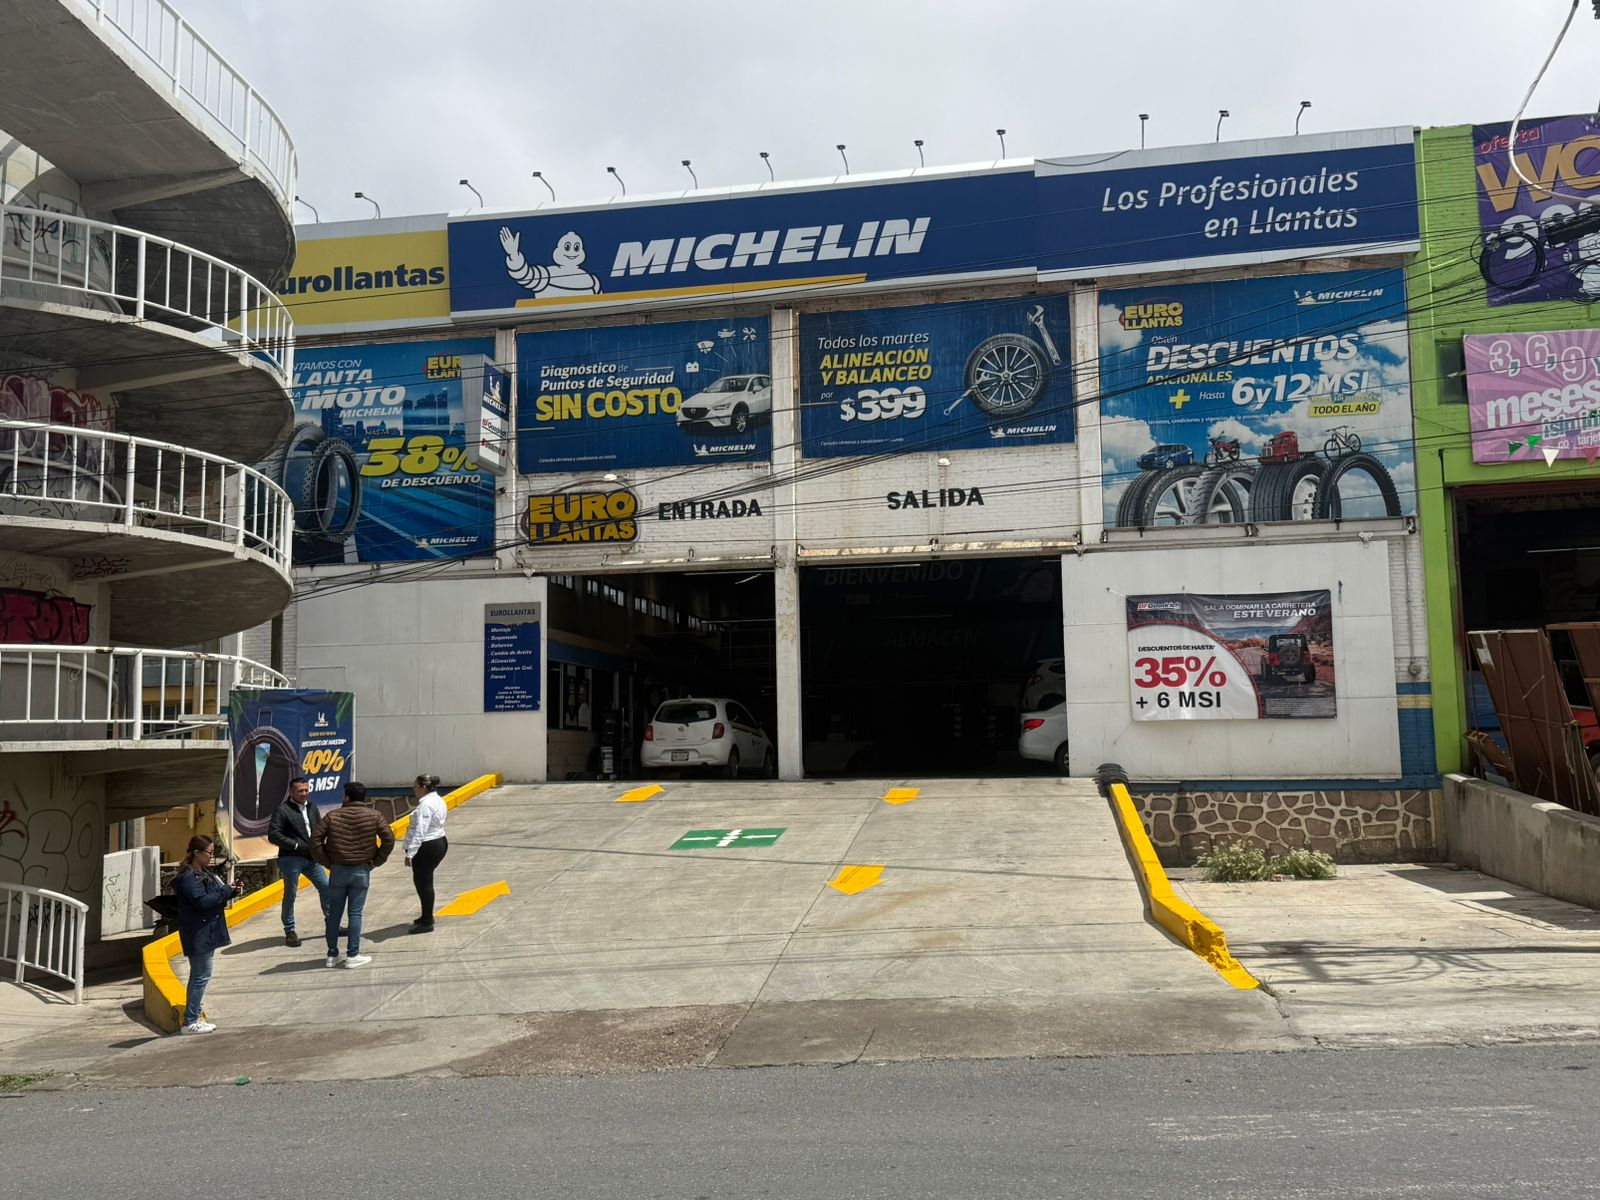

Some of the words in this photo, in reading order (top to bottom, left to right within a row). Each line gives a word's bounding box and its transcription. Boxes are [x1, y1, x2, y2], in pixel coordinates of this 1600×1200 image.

[1479, 127, 1539, 154] ofeta
[1476, 135, 1600, 212] WO
[1102, 187, 1150, 212] Los
[1159, 167, 1358, 211] Profesionales
[1204, 215, 1239, 238] en
[1249, 206, 1358, 235] Llantas
[610, 217, 931, 277] MICHELIN
[277, 263, 445, 296] urollantas
[1317, 288, 1384, 300] MICHELIN
[1125, 302, 1183, 319] EURO
[1124, 316, 1183, 330] LLANTAS
[818, 336, 856, 350] Todos
[859, 334, 879, 348] los
[882, 331, 929, 346] martes
[427, 356, 461, 369] EUR
[820, 346, 929, 369] ALINEACIÓN
[1146, 333, 1359, 372] DESCUENTOS
[294, 361, 336, 371] NTAMOS
[337, 359, 362, 369] CON
[541, 362, 616, 378] Diagnóstico
[618, 363, 628, 372] de
[1561, 346, 1586, 381] 9
[293, 369, 372, 387] LANTA
[427, 370, 461, 379] LLANT
[541, 377, 585, 391] Puntos
[588, 377, 604, 388] de
[607, 371, 674, 389] Seguridad
[821, 371, 835, 386] Y
[835, 364, 932, 385] BALANCEO
[1146, 371, 1232, 386] ADICIONALES
[1199, 390, 1226, 401] Hasta
[1316, 372, 1369, 395] MSI
[301, 386, 406, 410] MOTO
[536, 393, 581, 421] SIN
[587, 386, 683, 418] COSTO
[821, 391, 834, 400] por
[840, 385, 927, 422] $399
[1313, 405, 1339, 414] TODO
[1342, 404, 1353, 413] EL
[1355, 402, 1376, 413] AÑO
[1486, 379, 1600, 429] meses
[339, 406, 403, 418] MICHELIN
[1006, 424, 1056, 434] MICHELIN
[1578, 433, 1600, 446] tarje
[360, 435, 480, 476] 38%
[710, 443, 755, 452] MICHELIN
[381, 479, 400, 488] DE
[401, 474, 481, 487] DESCUENTO
[530, 491, 637, 523] EURO
[886, 487, 984, 510] SALIDA
[658, 499, 762, 521] ENTRADA
[430, 535, 478, 545] MICHELIN
[530, 521, 636, 543] LLANTAS
[825, 561, 964, 585] BIENVENIDO
[490, 608, 536, 617] EUROLLANTAS
[1138, 602, 1182, 611] BFGoodrich
[1233, 610, 1263, 618] ESTE
[1266, 608, 1316, 618] VERANO
[1135, 656, 1226, 688] 35%
[1136, 696, 1148, 709] +
[1157, 693, 1169, 708] 6
[1179, 692, 1221, 708] MSI
[303, 748, 345, 774] 40%
[315, 776, 340, 791] MSI
